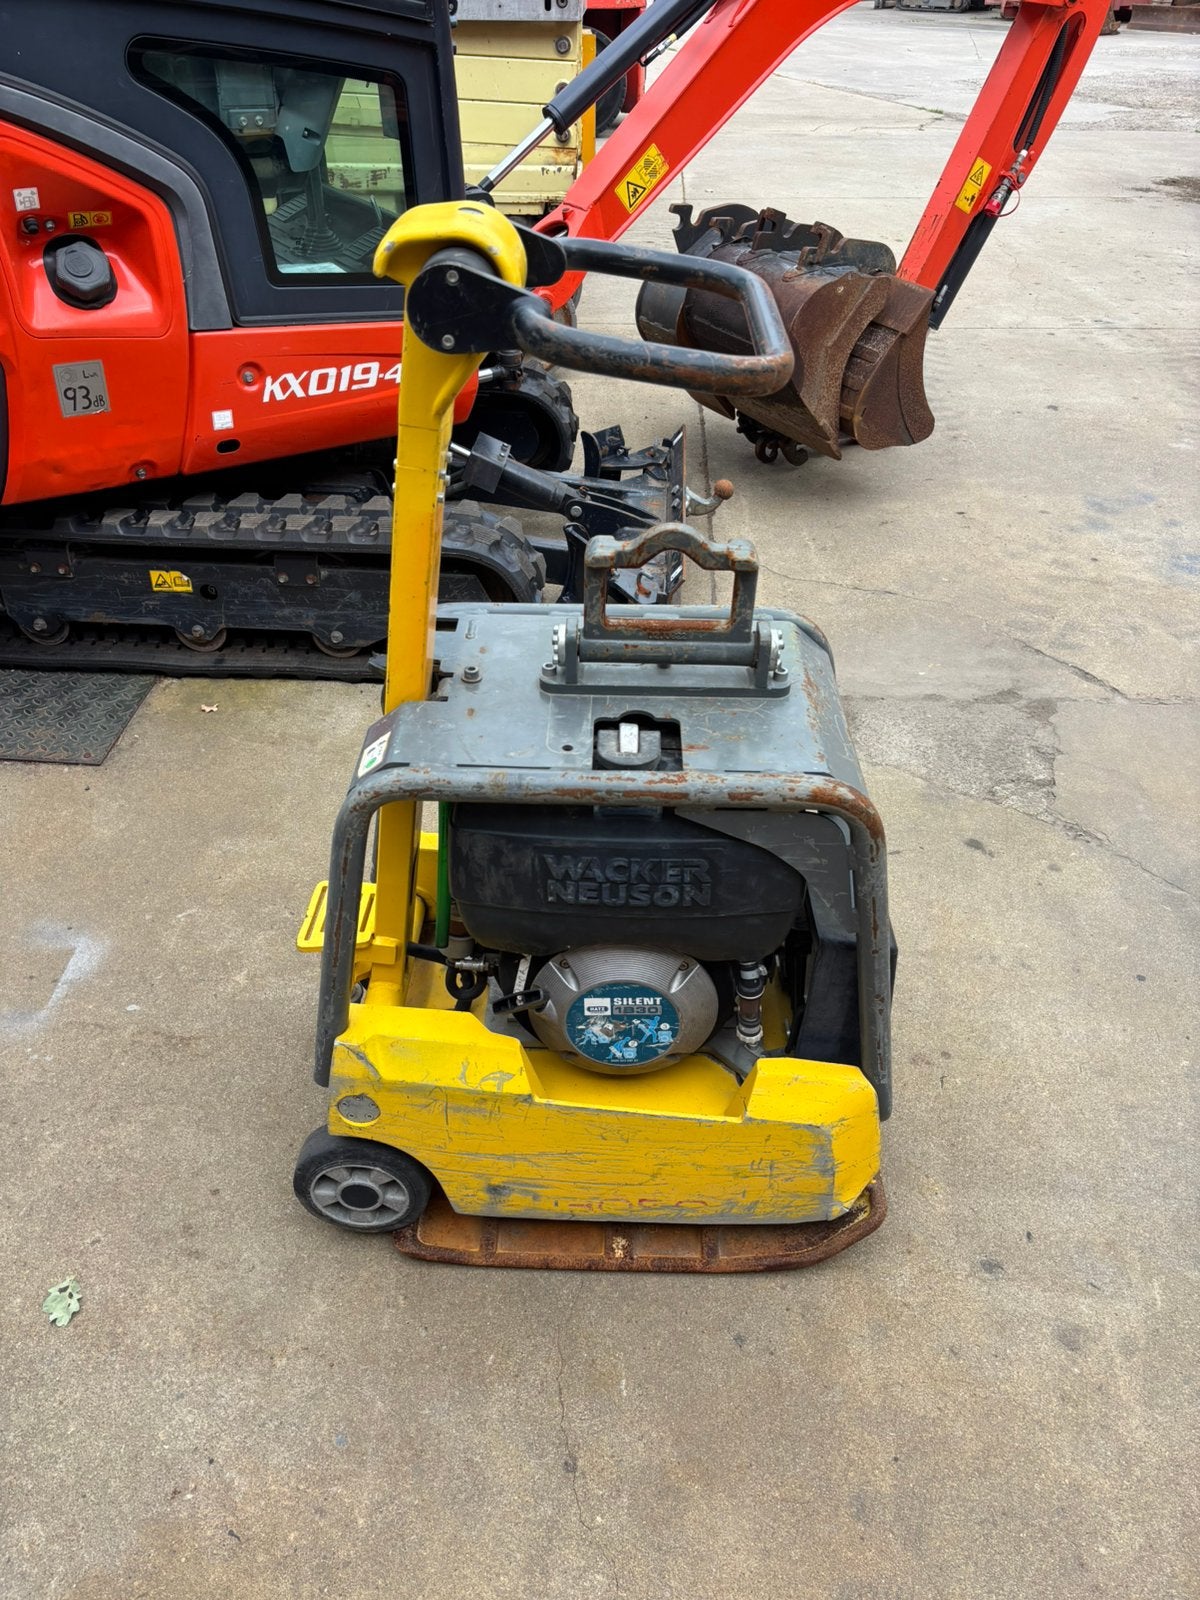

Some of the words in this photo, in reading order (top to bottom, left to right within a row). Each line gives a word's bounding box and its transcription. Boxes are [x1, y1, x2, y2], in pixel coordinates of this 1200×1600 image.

[544, 854, 712, 884] WACKER
[547, 880, 712, 907] NEUSON
[613, 996, 662, 1006] SILENT
